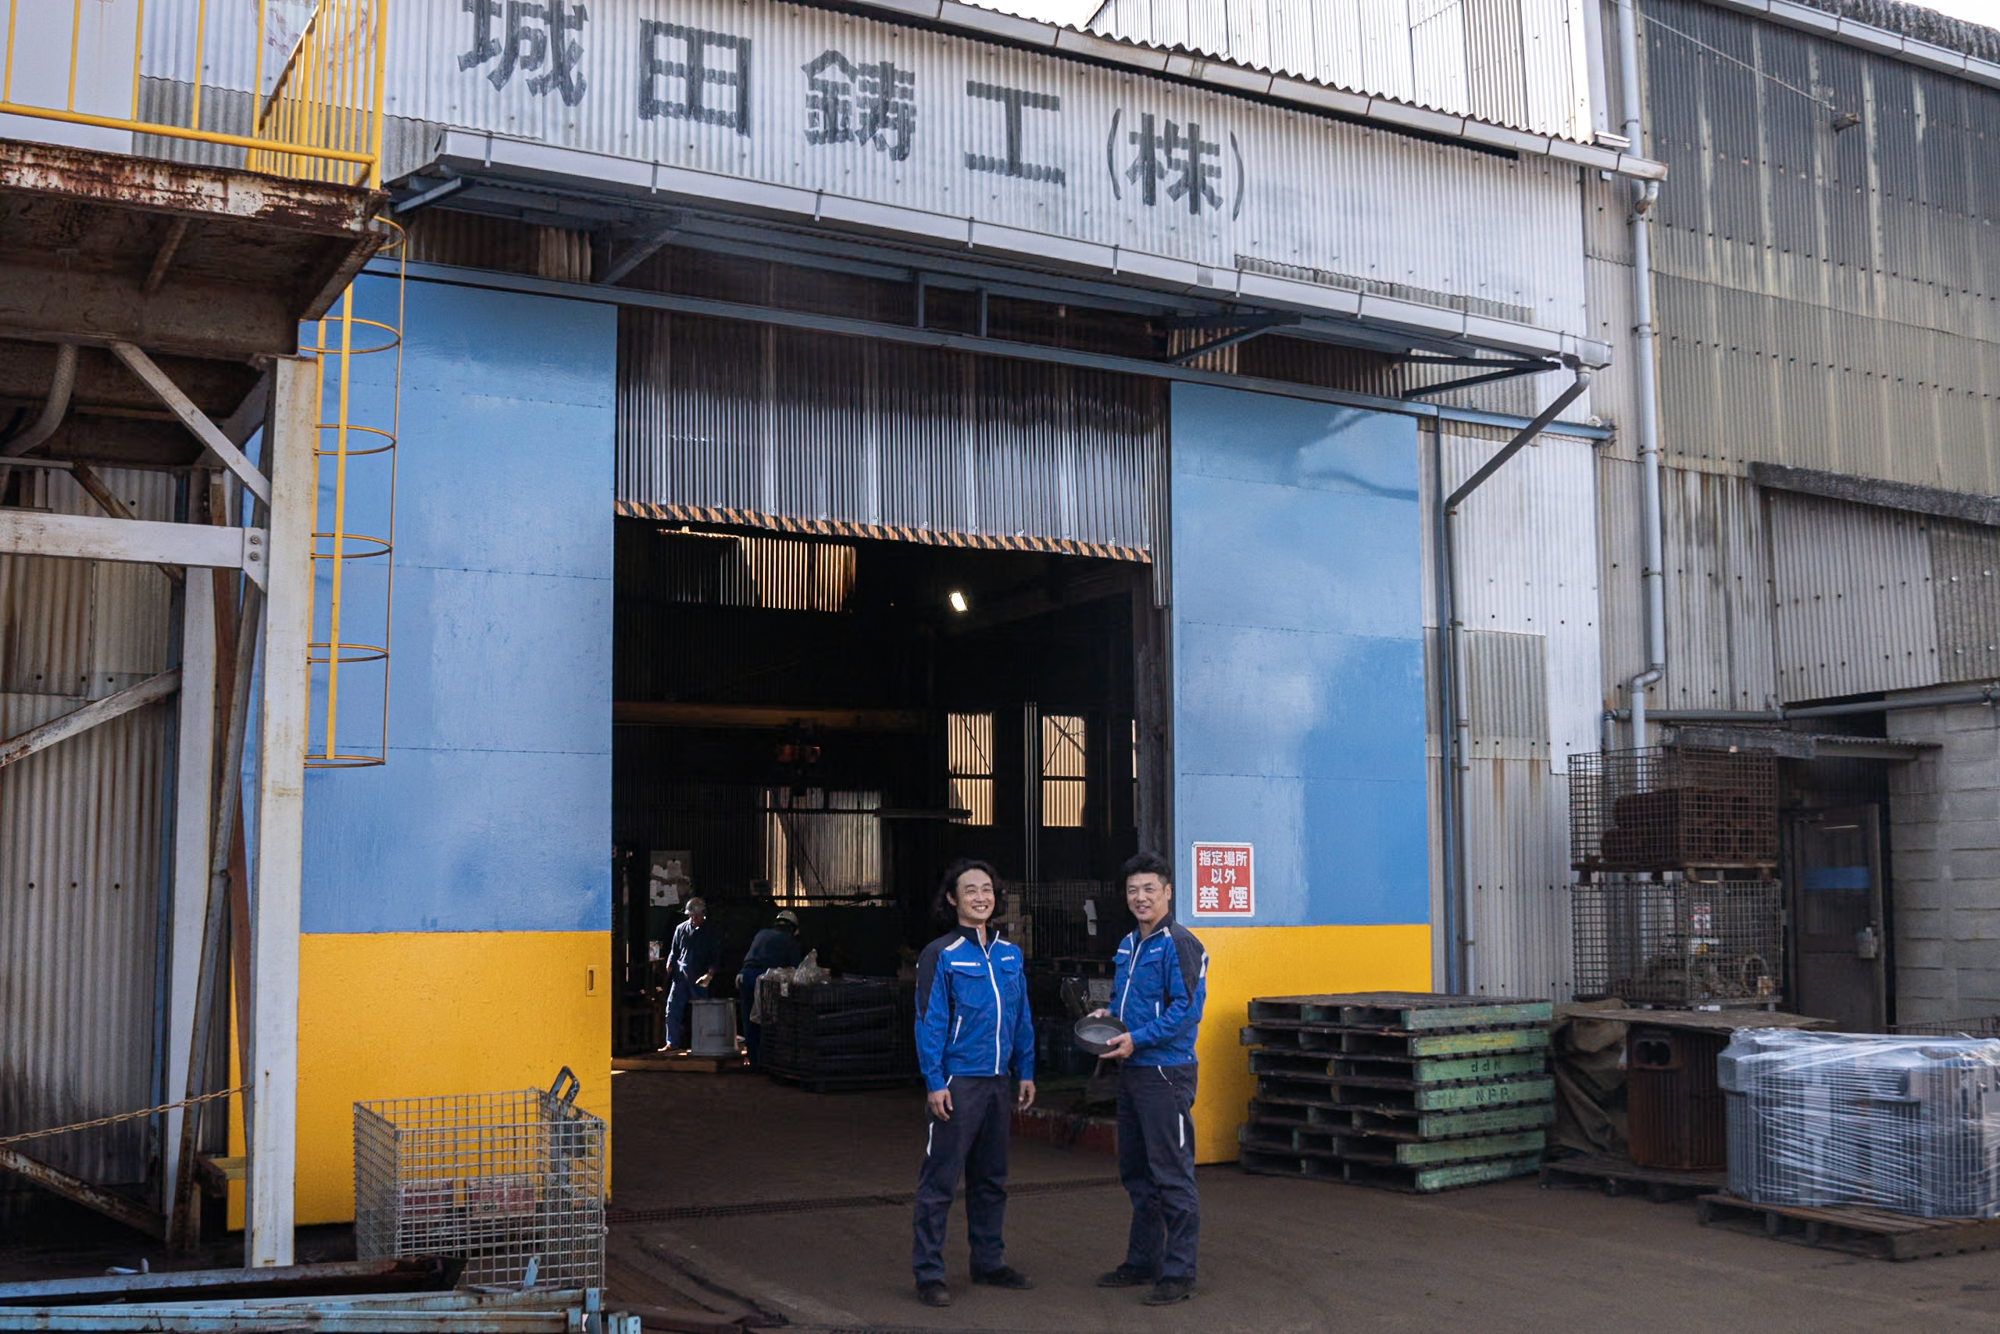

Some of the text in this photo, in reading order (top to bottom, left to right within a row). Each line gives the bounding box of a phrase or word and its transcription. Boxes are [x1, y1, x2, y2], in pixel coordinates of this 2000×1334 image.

[1199, 850, 1248, 867] 指定場所
[1211, 868, 1237, 885] 以外
[1199, 886, 1248, 910] 禁煙
